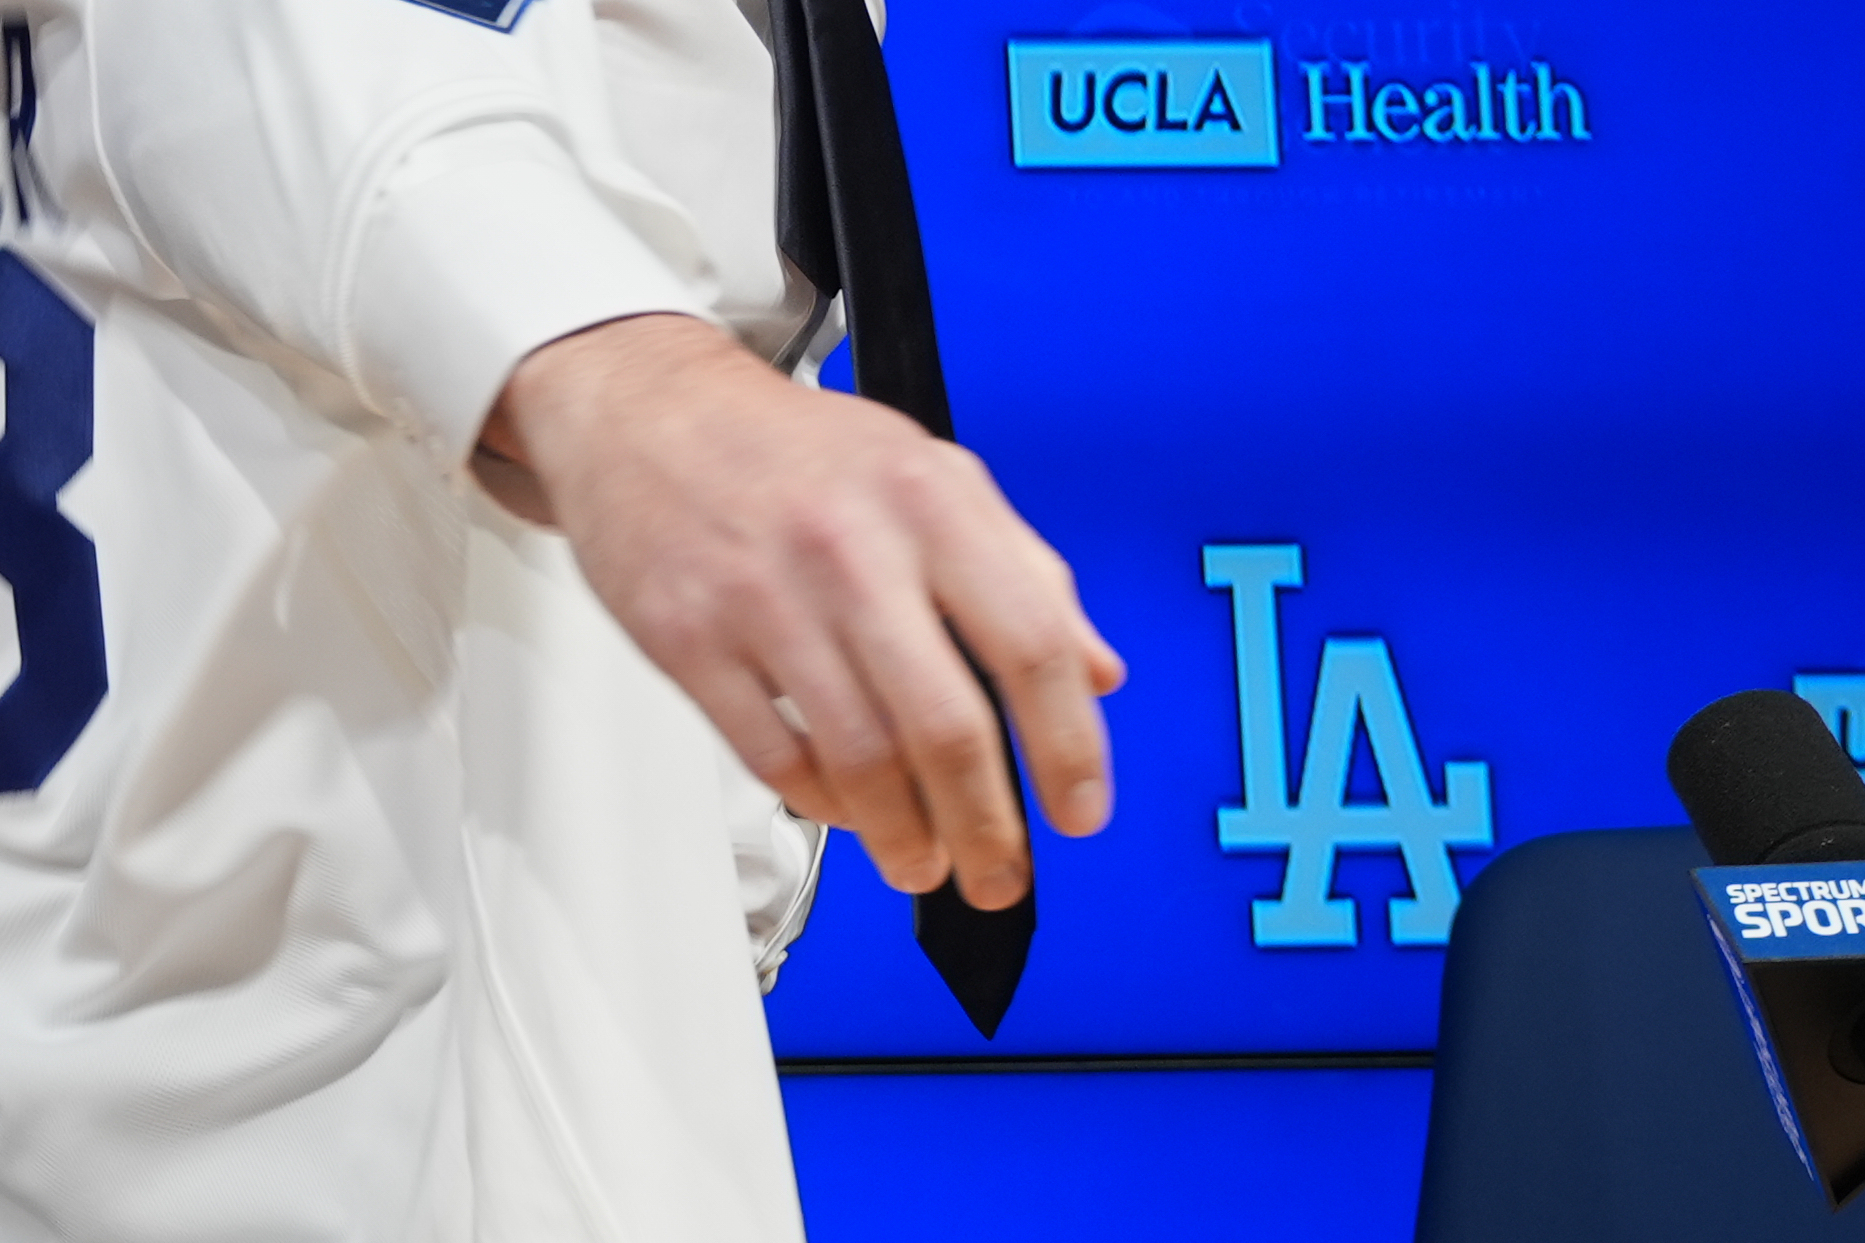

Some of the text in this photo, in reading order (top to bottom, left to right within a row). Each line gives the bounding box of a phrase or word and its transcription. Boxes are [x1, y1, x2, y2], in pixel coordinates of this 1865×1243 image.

[1050, 60, 1592, 145] UCLA Health
[1203, 544, 1494, 947] LA
[1725, 879, 1865, 904] SPECTRUM
